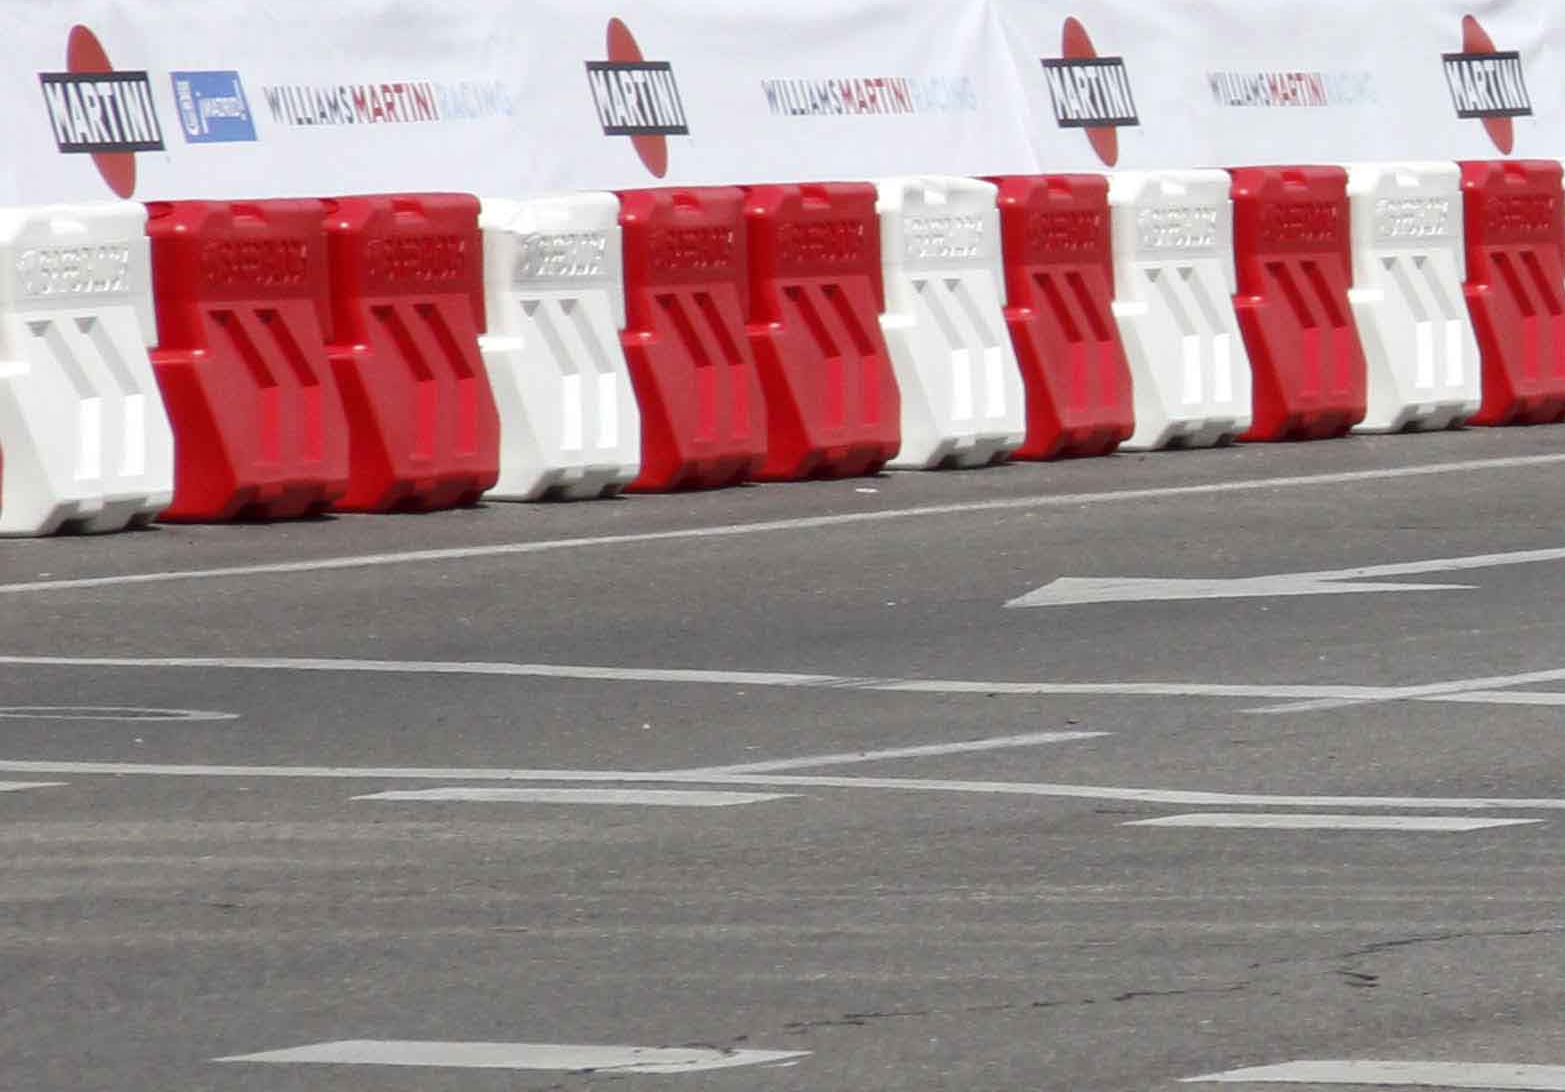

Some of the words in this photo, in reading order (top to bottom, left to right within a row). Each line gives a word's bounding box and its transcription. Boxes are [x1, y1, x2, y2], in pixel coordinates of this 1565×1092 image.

[43, 80, 161, 143] MARTINI
[589, 70, 684, 127] MARTINI
[1044, 64, 1138, 120] MARTINI
[1443, 59, 1531, 110] MARTINI
